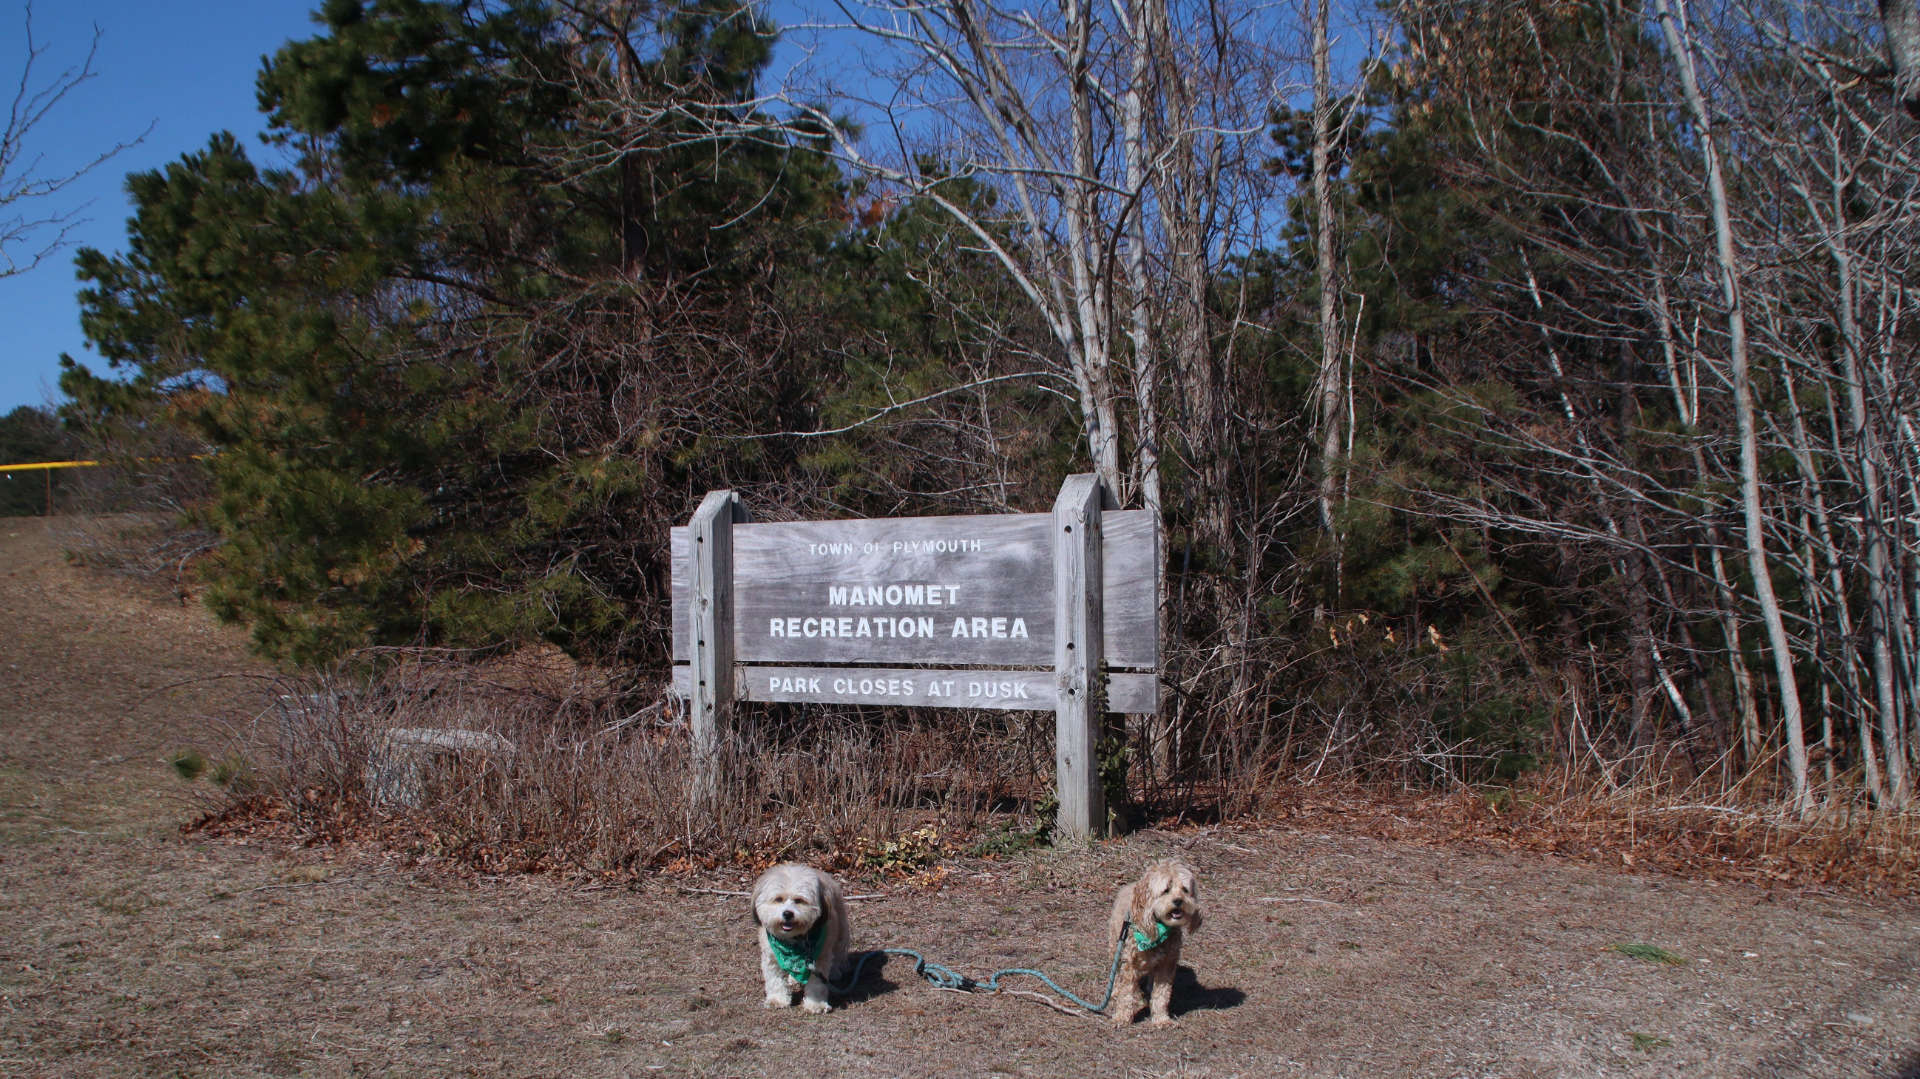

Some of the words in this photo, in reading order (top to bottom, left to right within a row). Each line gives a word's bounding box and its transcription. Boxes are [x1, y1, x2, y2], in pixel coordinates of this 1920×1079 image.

[808, 542, 854, 556] TOWN
[892, 539, 983, 554] PLYMOUTH
[828, 584, 961, 606] MANOMET
[769, 617, 934, 639] RECREATION
[951, 617, 1030, 639] AREA
[769, 677, 821, 694] PARK
[833, 679, 914, 697] CLOSES
[928, 681, 957, 698] AT
[968, 681, 1029, 700] DUSK
